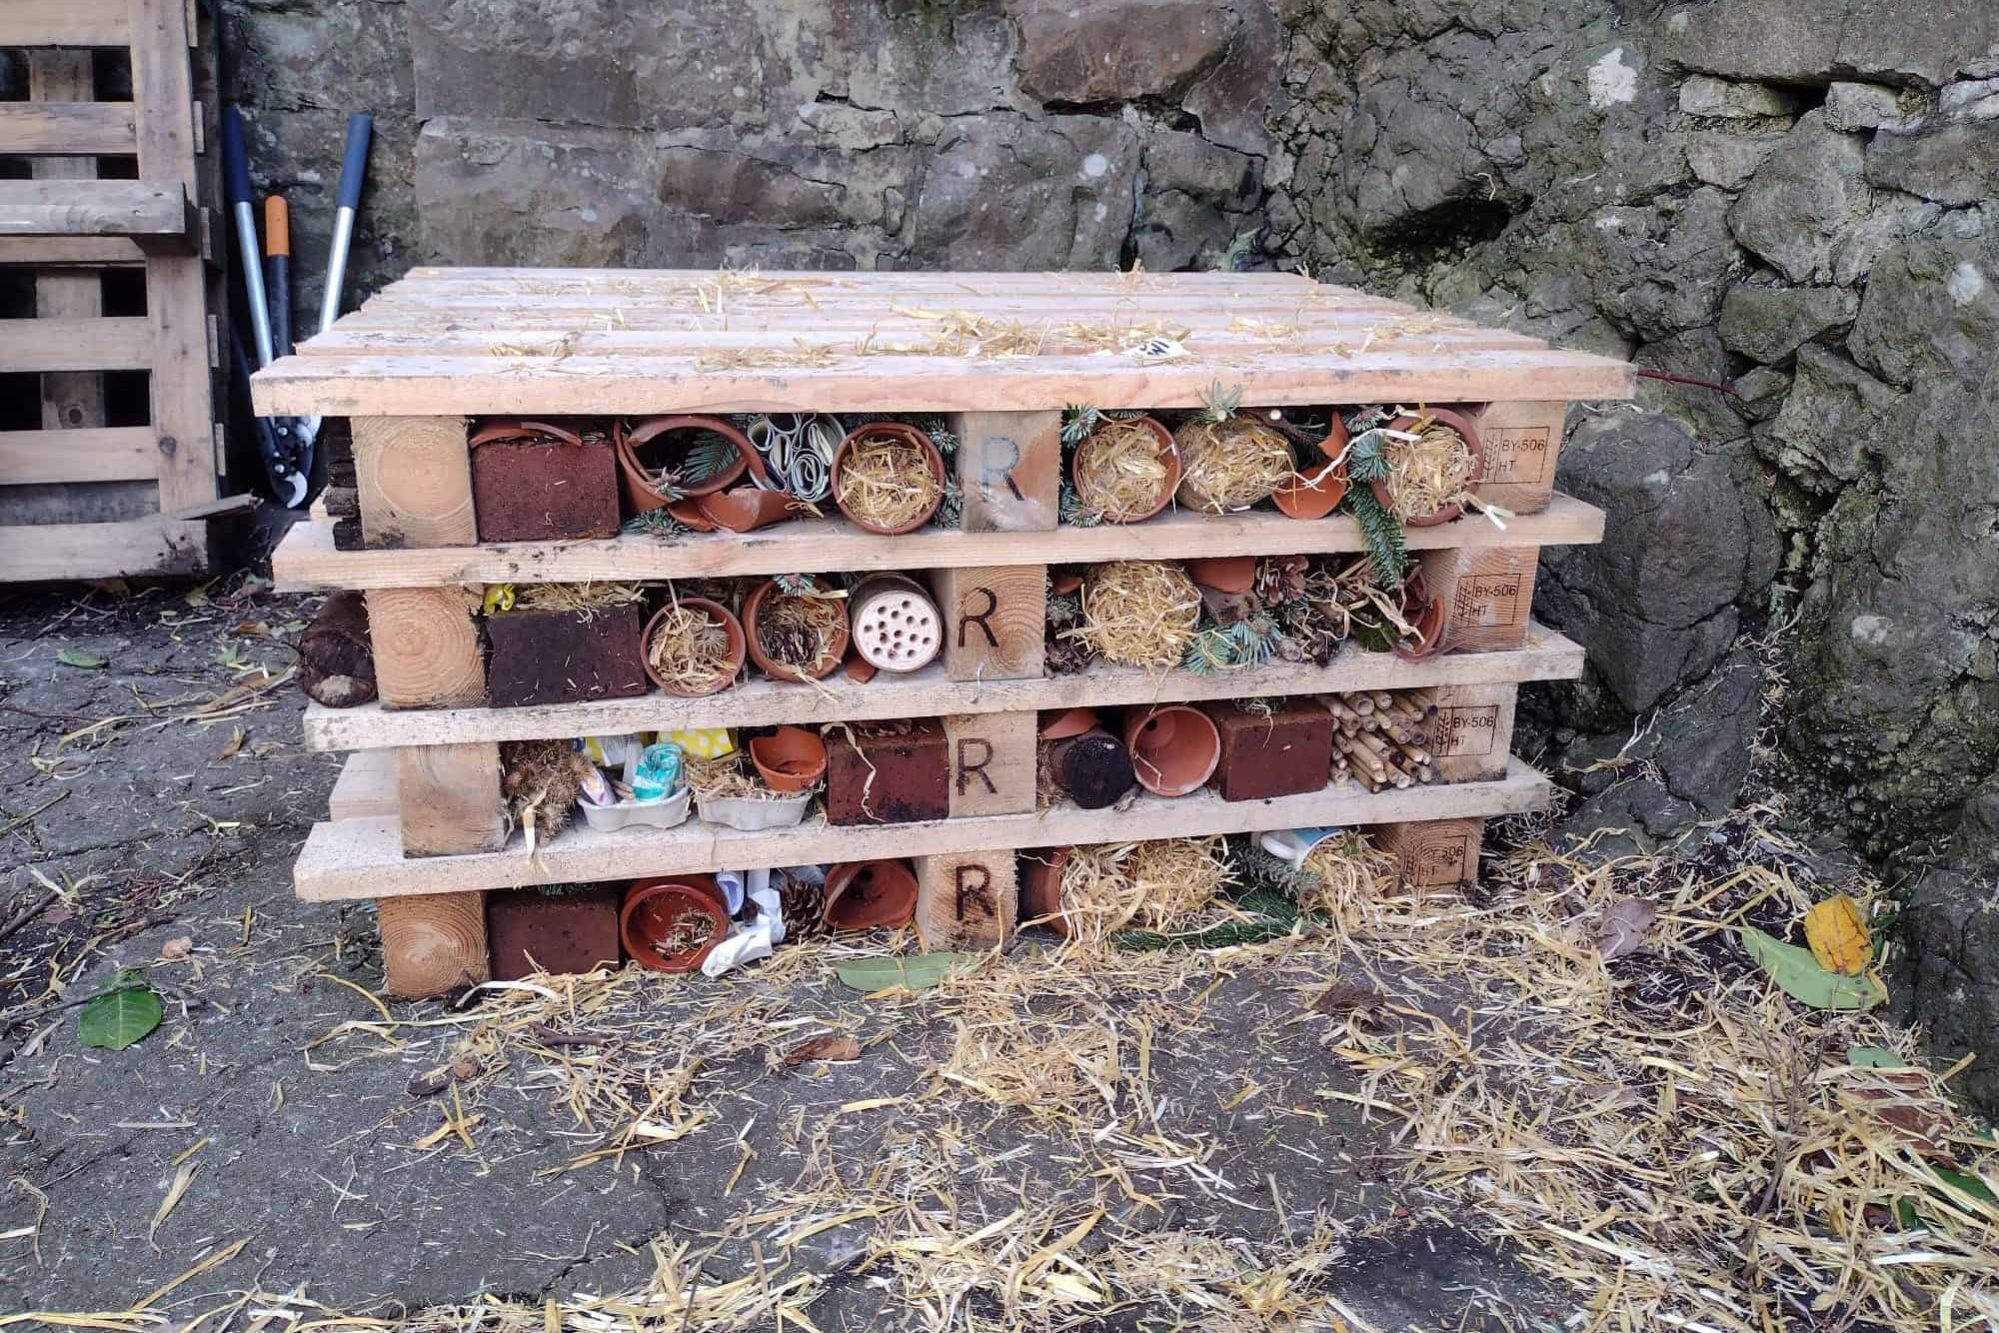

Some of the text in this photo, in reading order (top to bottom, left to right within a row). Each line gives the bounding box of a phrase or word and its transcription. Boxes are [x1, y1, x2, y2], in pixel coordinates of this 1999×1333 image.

[1501, 438, 1545, 452] BY-506
[983, 436, 1024, 502] R
[1498, 460, 1516, 472] HT
[1474, 585, 1517, 598] BY-506
[958, 586, 999, 648] R
[1471, 604, 1488, 617] HT
[1452, 715, 1494, 729] BY-506
[1450, 735, 1466, 747] HT
[956, 738, 998, 796] R
[956, 863, 995, 921] R
